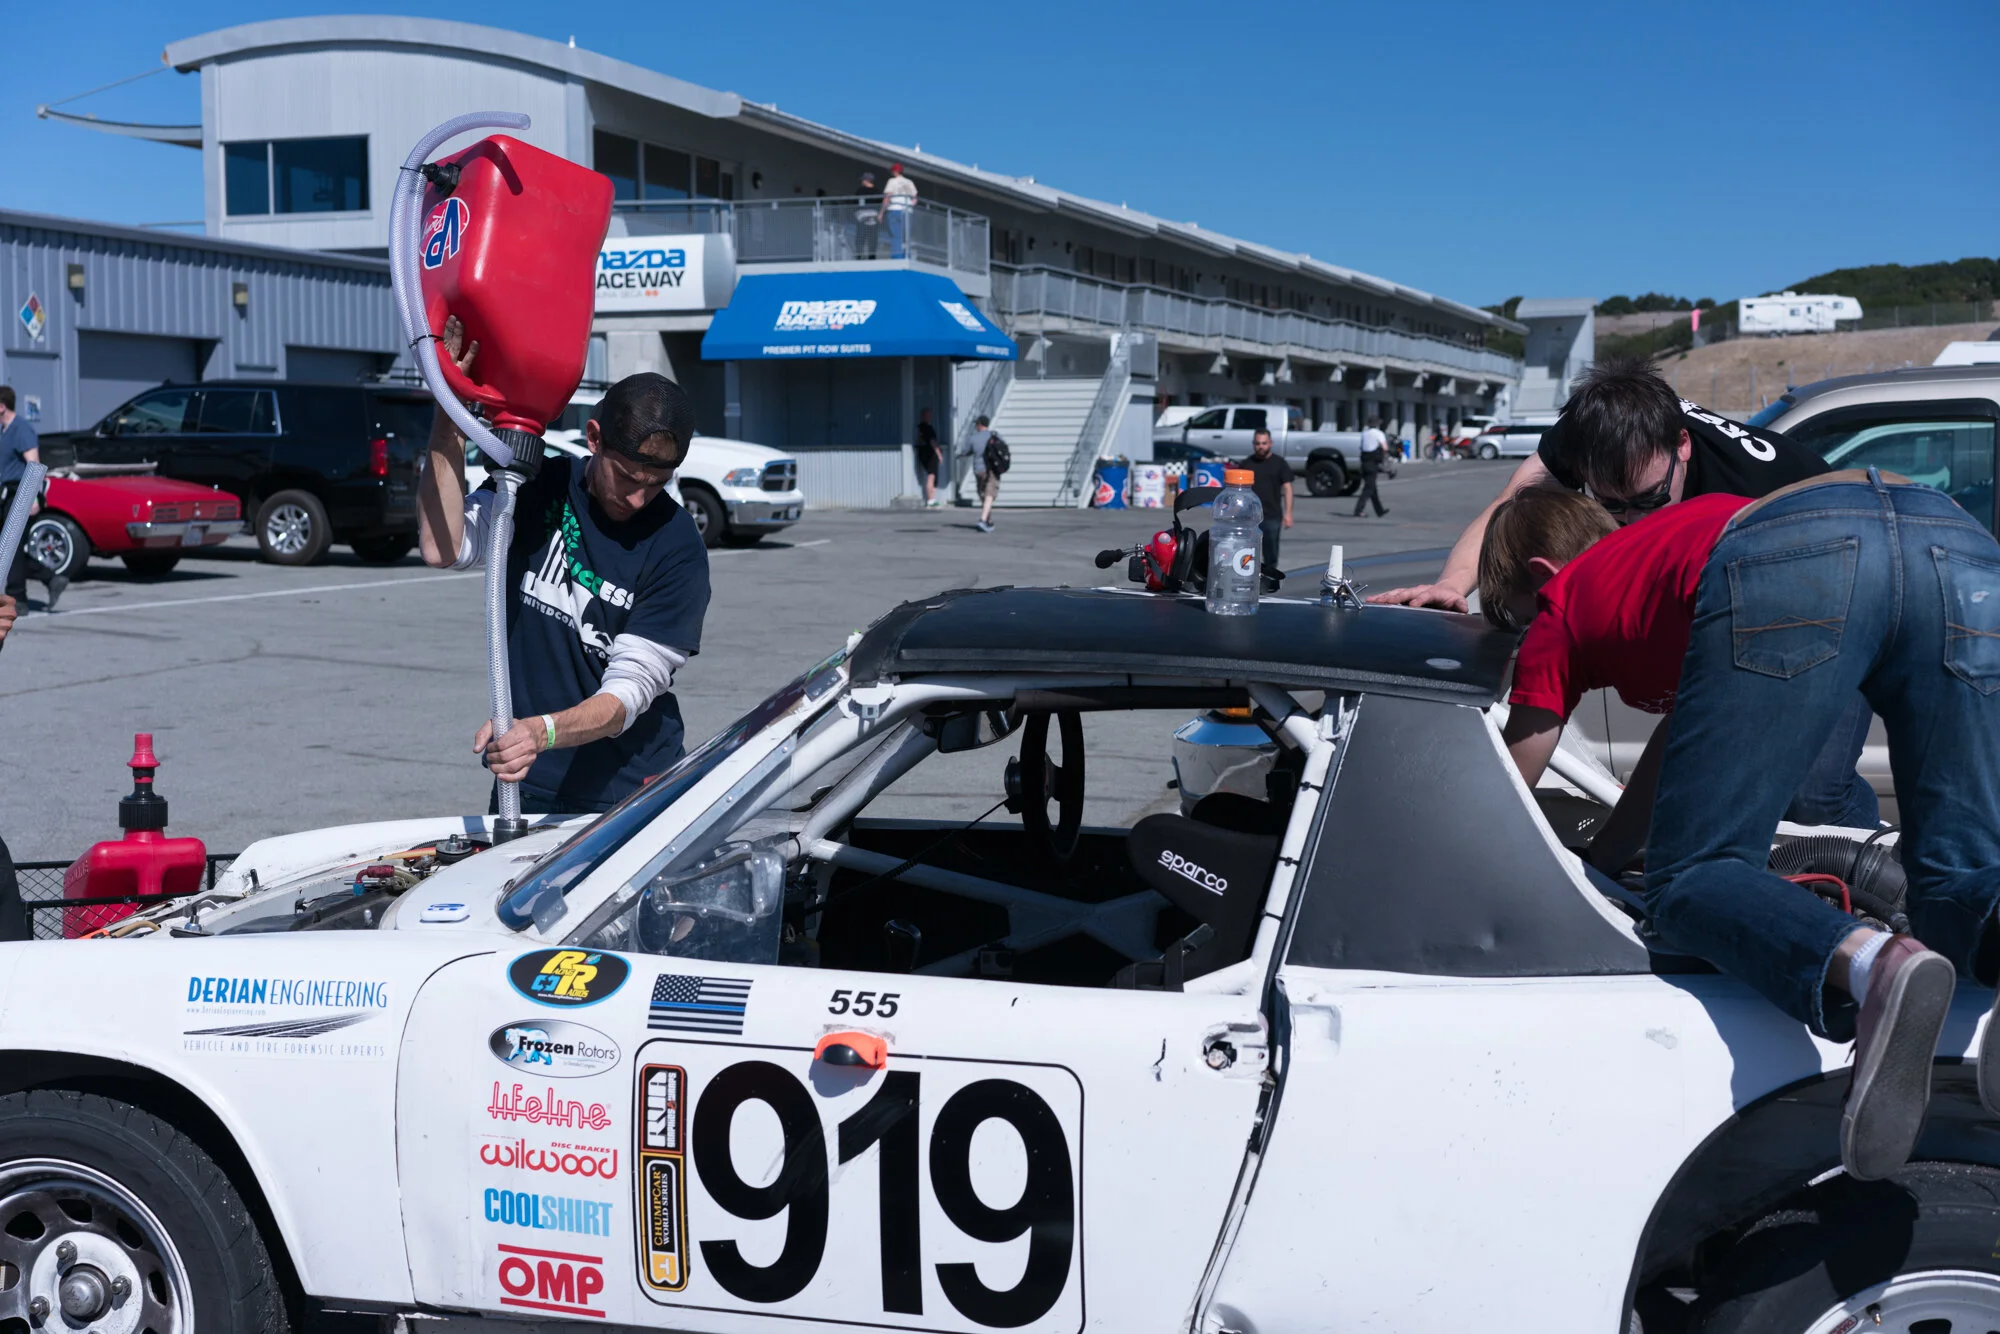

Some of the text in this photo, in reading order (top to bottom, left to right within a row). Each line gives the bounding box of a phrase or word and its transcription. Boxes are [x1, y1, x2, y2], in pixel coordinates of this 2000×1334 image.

[424, 198, 460, 270] VP
[597, 271, 684, 289] ACEWAY
[776, 312, 872, 327] RACEWAY
[763, 343, 871, 355] PREMIER PIT ROW SUITES
[1232, 548, 1255, 576] G
[1159, 850, 1228, 893] sparco
[188, 977, 388, 1008] DERIAN ENGINEERING
[828, 989, 900, 1018] 555
[183, 1040, 385, 1057] VEHICLE AND TIRE FORENSIC EXPERTS
[519, 1035, 616, 1061] Frozen Rotors
[487, 1080, 612, 1131] lifeline
[480, 1138, 618, 1180] wilwood
[551, 1141, 611, 1154] DISC BRAKES
[484, 1187, 613, 1237] COOLSHIRT
[652, 1170, 663, 1246] CHUMPCAR
[661, 1172, 670, 1246] WORLD SERIES
[692, 1060, 1075, 1329] 919
[498, 1256, 604, 1306] OMP
